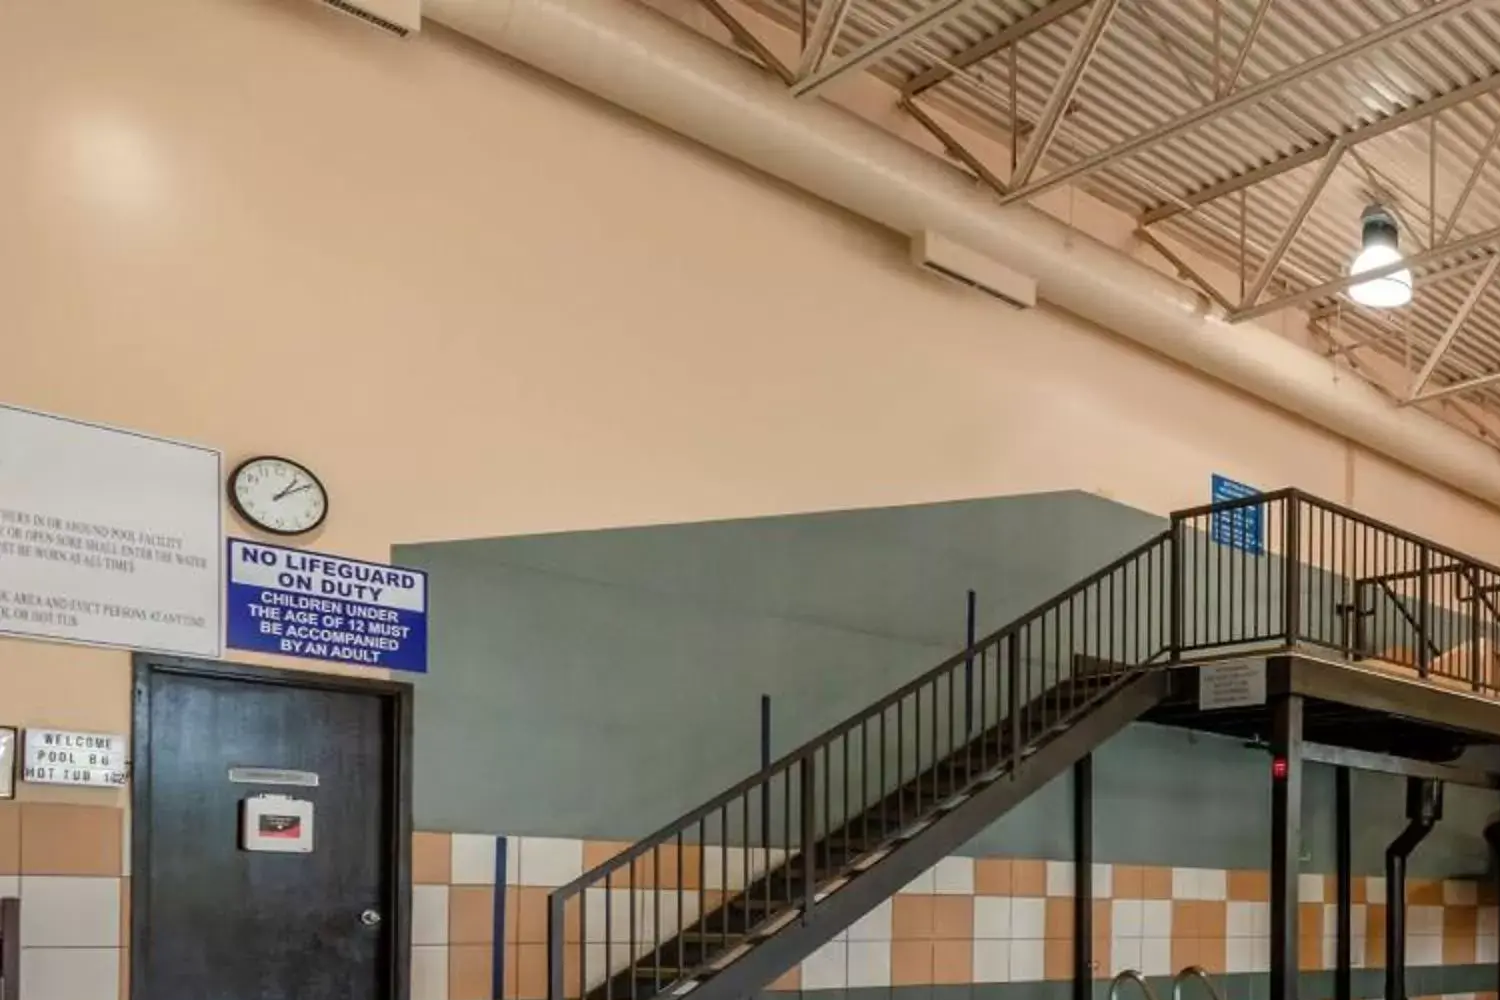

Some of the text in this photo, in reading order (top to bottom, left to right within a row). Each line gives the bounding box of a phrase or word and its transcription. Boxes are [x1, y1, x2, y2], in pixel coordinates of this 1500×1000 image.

[242, 546, 415, 589] NO LIFEGUARD
[278, 572, 384, 602] ON DUTY
[248, 603, 411, 639] THE AGE OF 12 MUST
[261, 591, 399, 623] CHILDREN UNDER
[259, 621, 399, 651] BE ACCOMPANIED
[280, 638, 381, 663] BY AN ADULT
[44, 733, 112, 749] WELCOME
[37, 750, 75, 764] POOL
[25, 767, 55, 781] HOT
